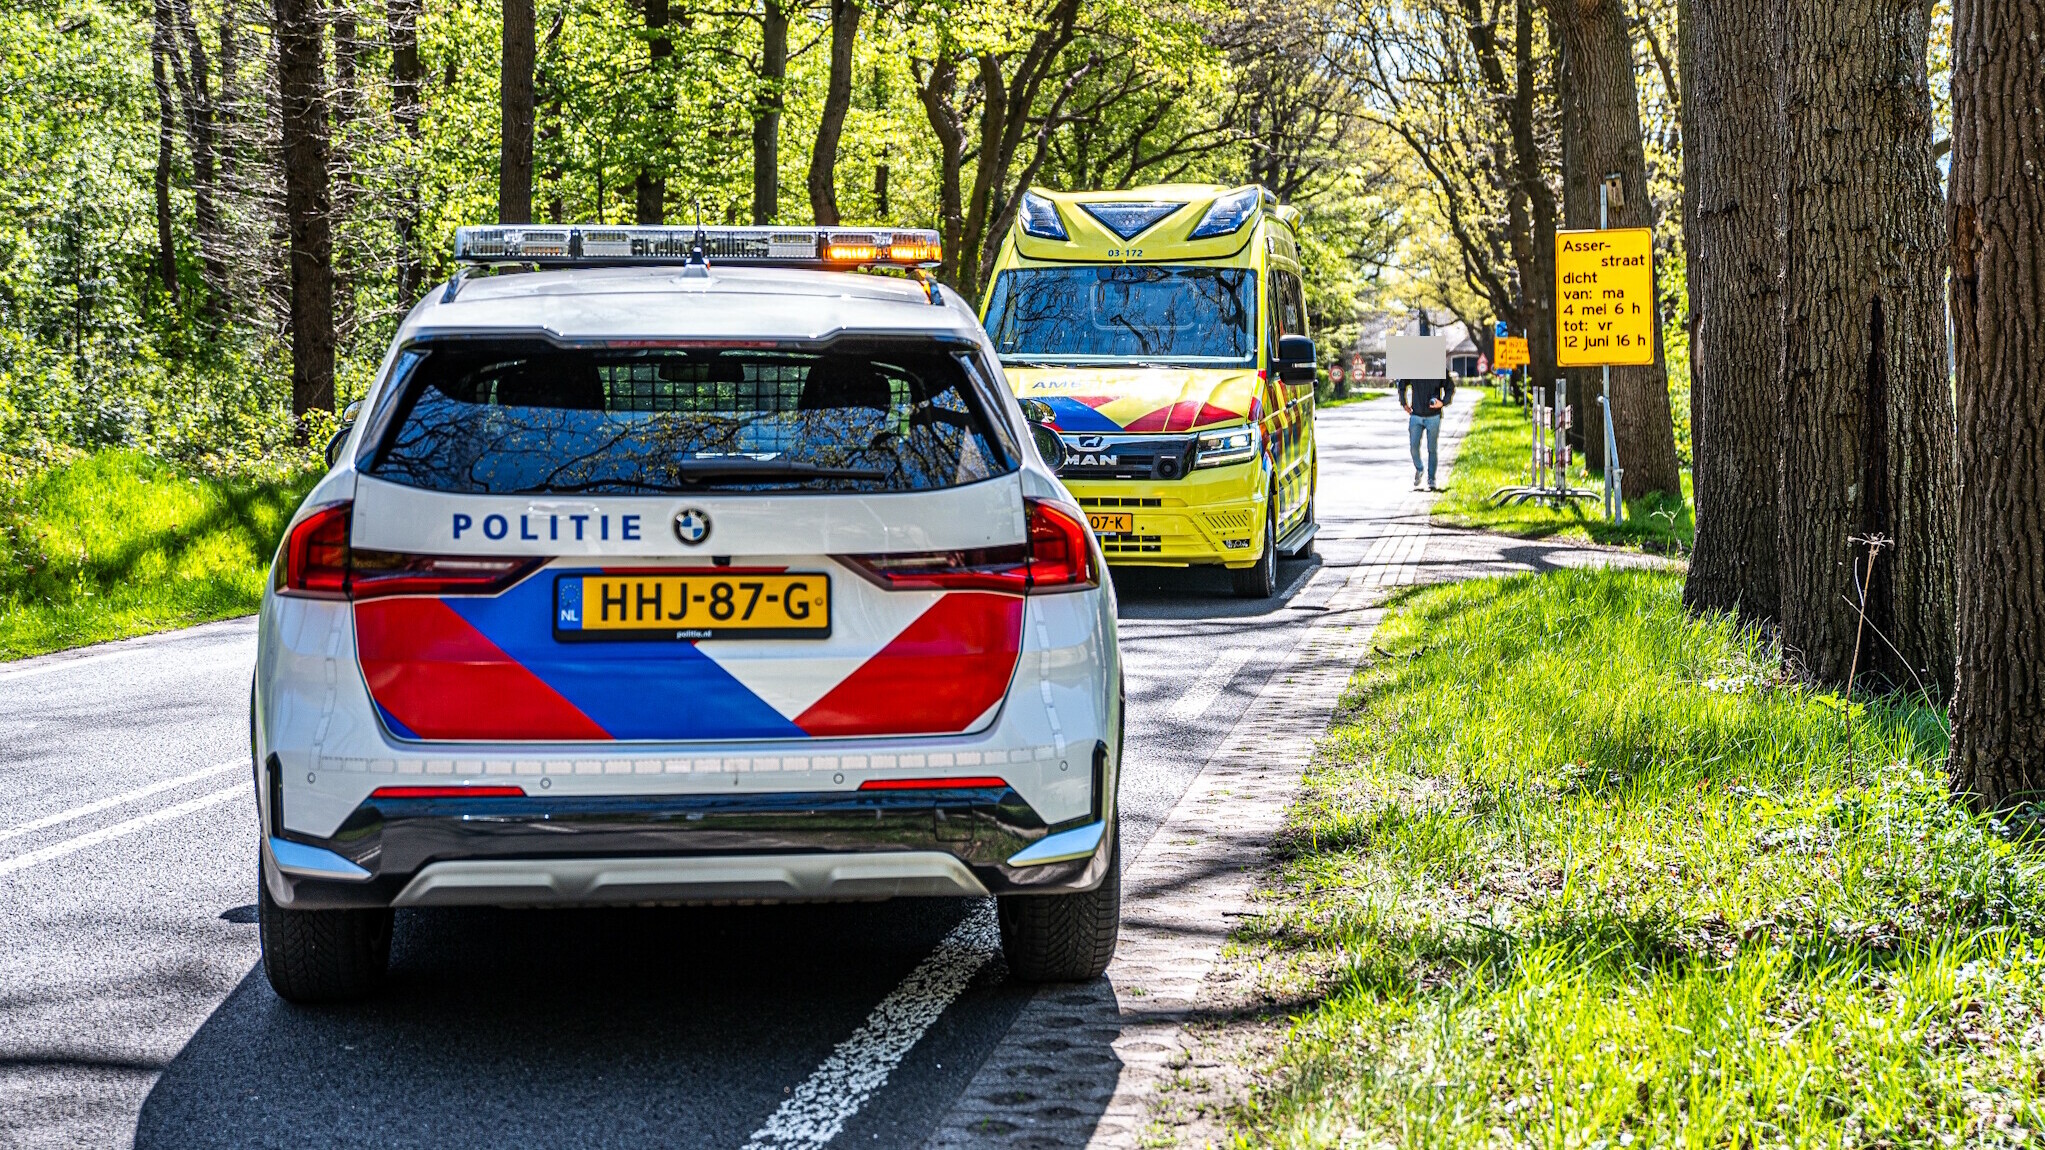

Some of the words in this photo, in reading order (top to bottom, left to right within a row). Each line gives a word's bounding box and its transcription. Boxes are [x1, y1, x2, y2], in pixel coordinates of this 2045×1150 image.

[1563, 240, 1612, 252] Asser-
[1108, 249, 1143, 257] 03-172
[1601, 254, 1645, 267] straat
[1563, 272, 1598, 284] dicht
[1564, 290, 1592, 299] van:
[1603, 289, 1624, 299] ma
[1563, 304, 1574, 315] 4
[1582, 303, 1607, 315] mei
[1615, 303, 1624, 314] 6
[1632, 302, 1641, 314] h
[1563, 320, 1588, 331] tot:
[1598, 321, 1613, 331] vr
[1564, 336, 1578, 347] 12
[1583, 335, 1609, 351] juni
[1616, 335, 1630, 346] 16
[1637, 335, 1646, 346] h
[1065, 454, 1118, 466] MAN
[452, 513, 642, 541] POLITIE
[601, 581, 809, 621] HHJ-87-G
[560, 609, 579, 622] NL
[676, 629, 713, 639] politie.nl
